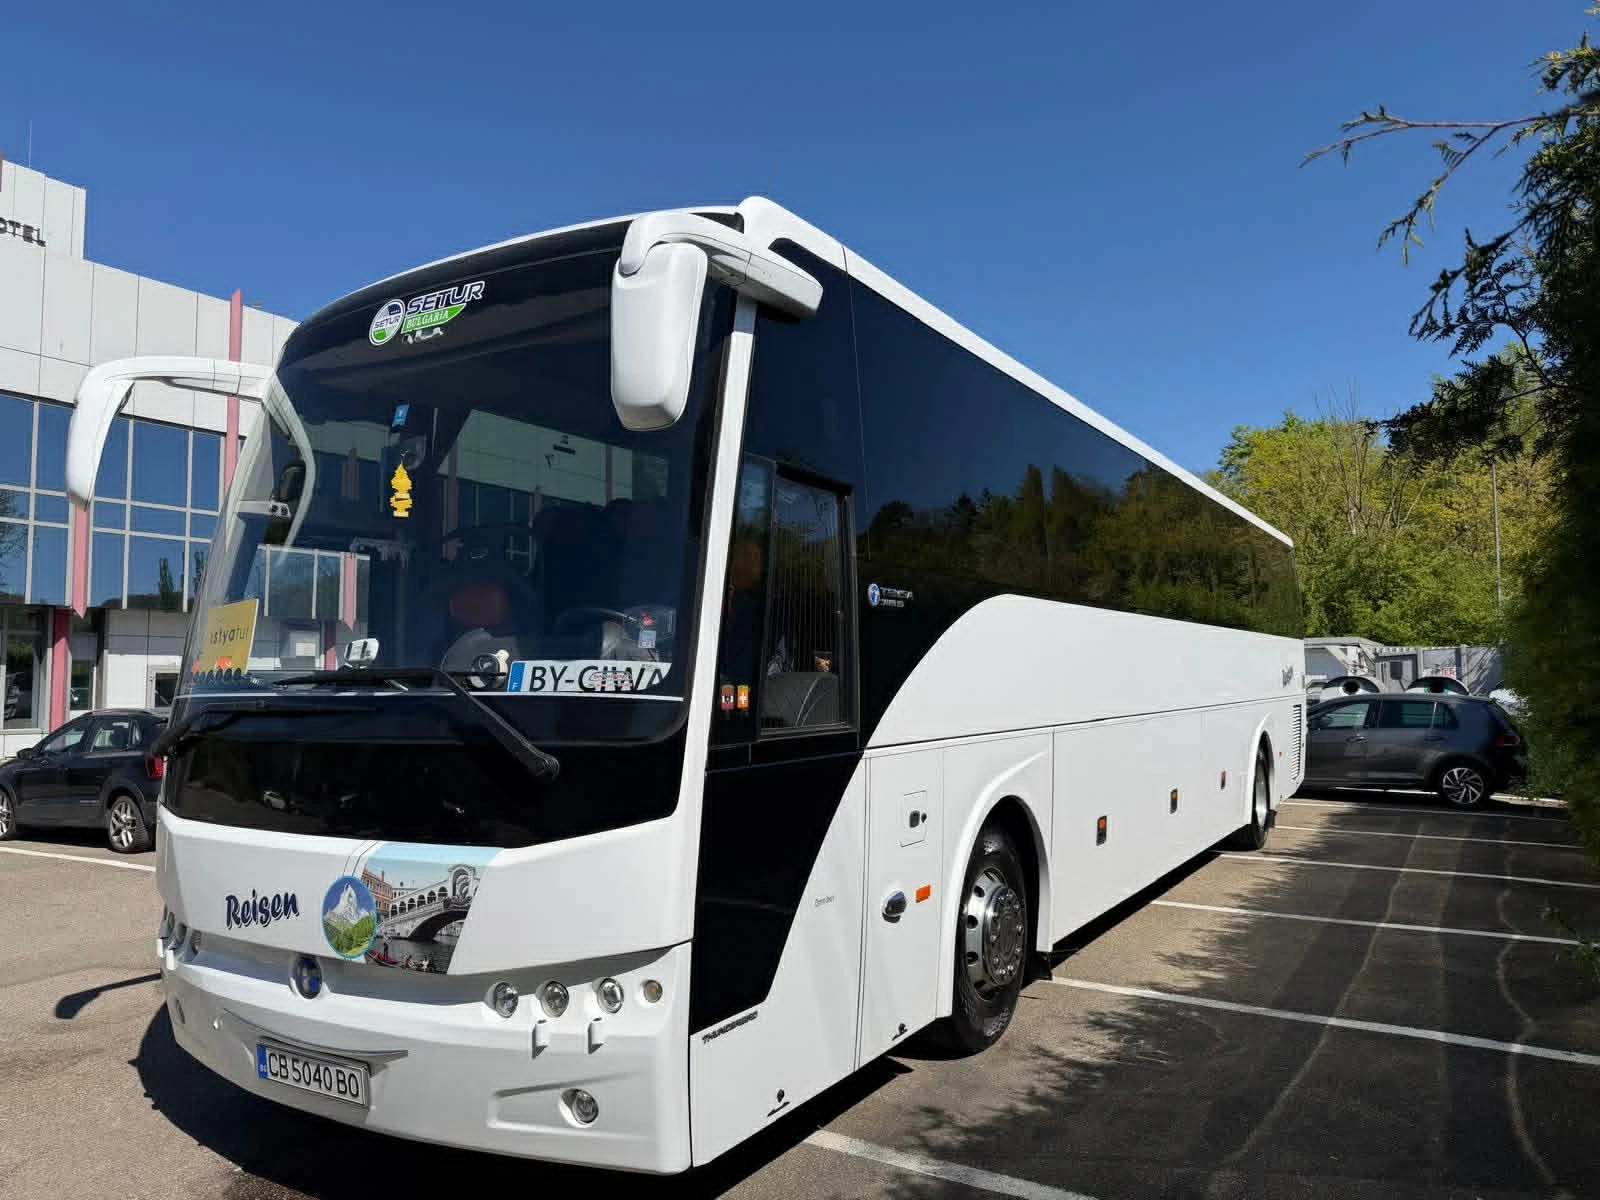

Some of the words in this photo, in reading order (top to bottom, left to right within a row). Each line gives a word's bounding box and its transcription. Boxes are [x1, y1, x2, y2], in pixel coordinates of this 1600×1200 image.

[405, 280, 485, 316] SETUR
[406, 309, 450, 329] BULGARIA
[225, 889, 300, 930] Reisen
[268, 1053, 289, 1079] CB
[291, 1058, 333, 1091] 5040
[336, 1069, 360, 1097] BO
